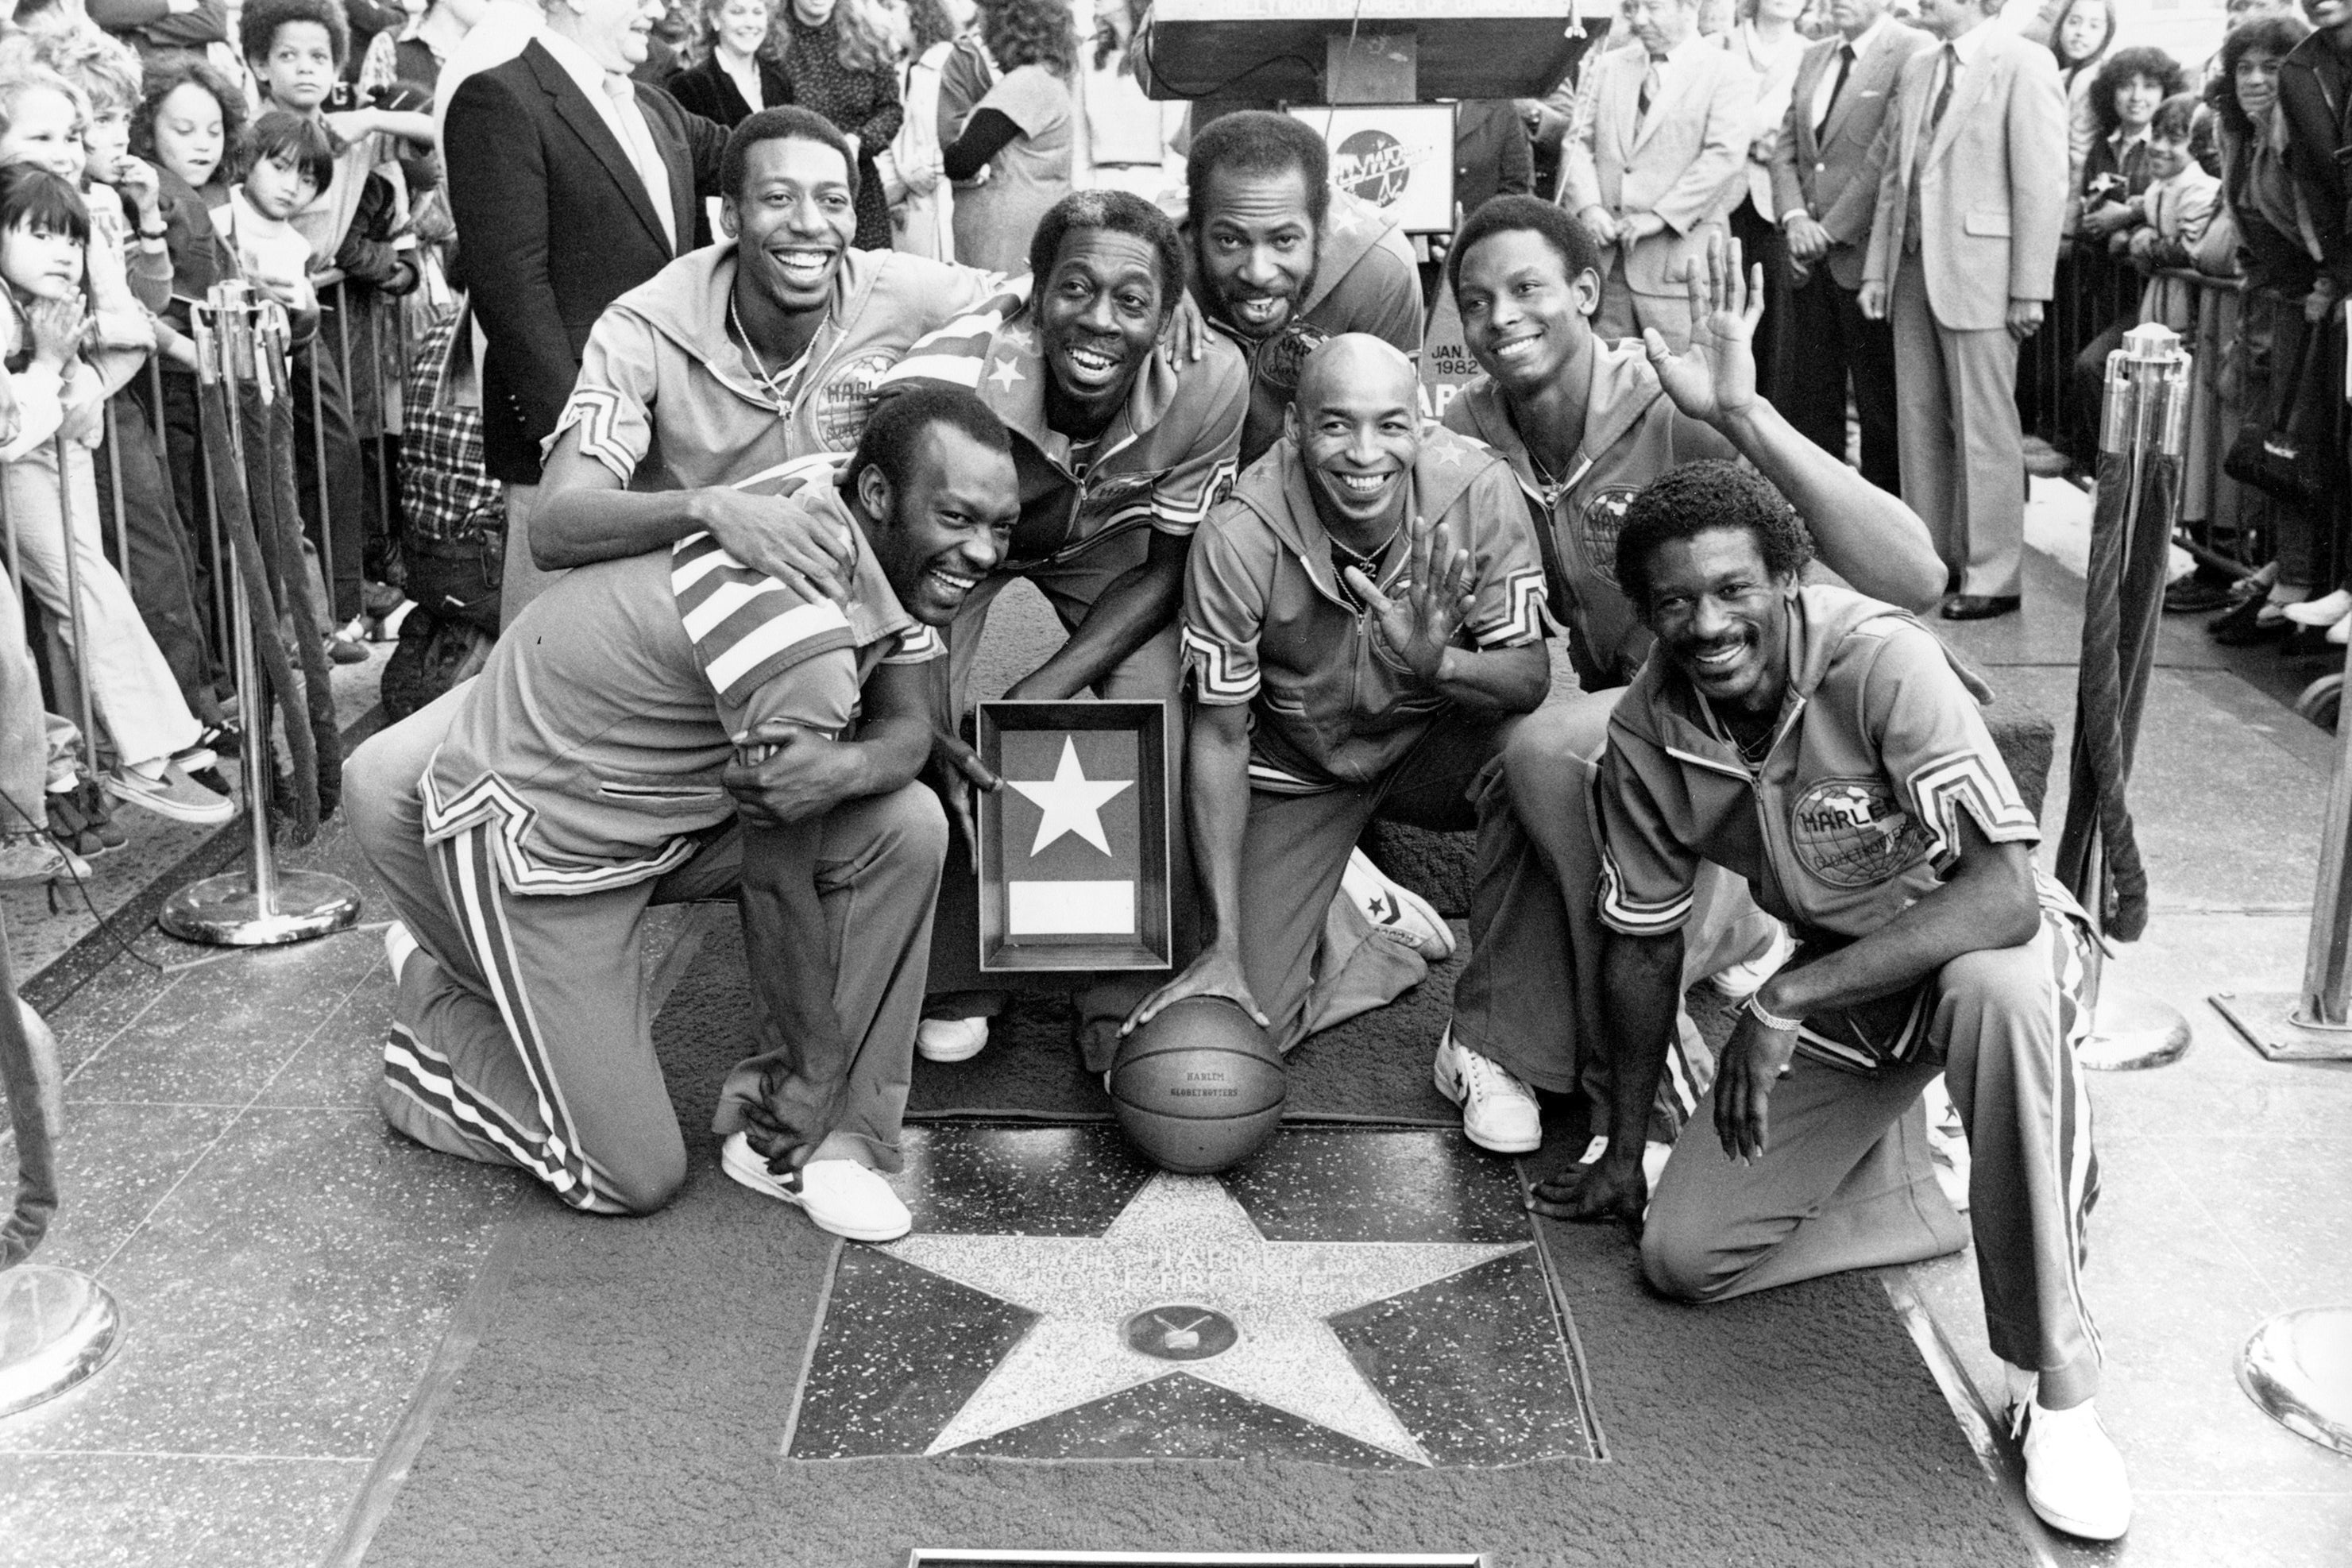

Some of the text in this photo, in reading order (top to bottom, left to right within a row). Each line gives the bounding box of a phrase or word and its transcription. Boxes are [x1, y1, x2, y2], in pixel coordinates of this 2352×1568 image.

[1435, 359, 1478, 375] 1982
[1801, 798, 1888, 832] HARLE
[1187, 1072, 1225, 1081] HARLEM
[1170, 1088, 1238, 1097] GLOBETROTTERS
